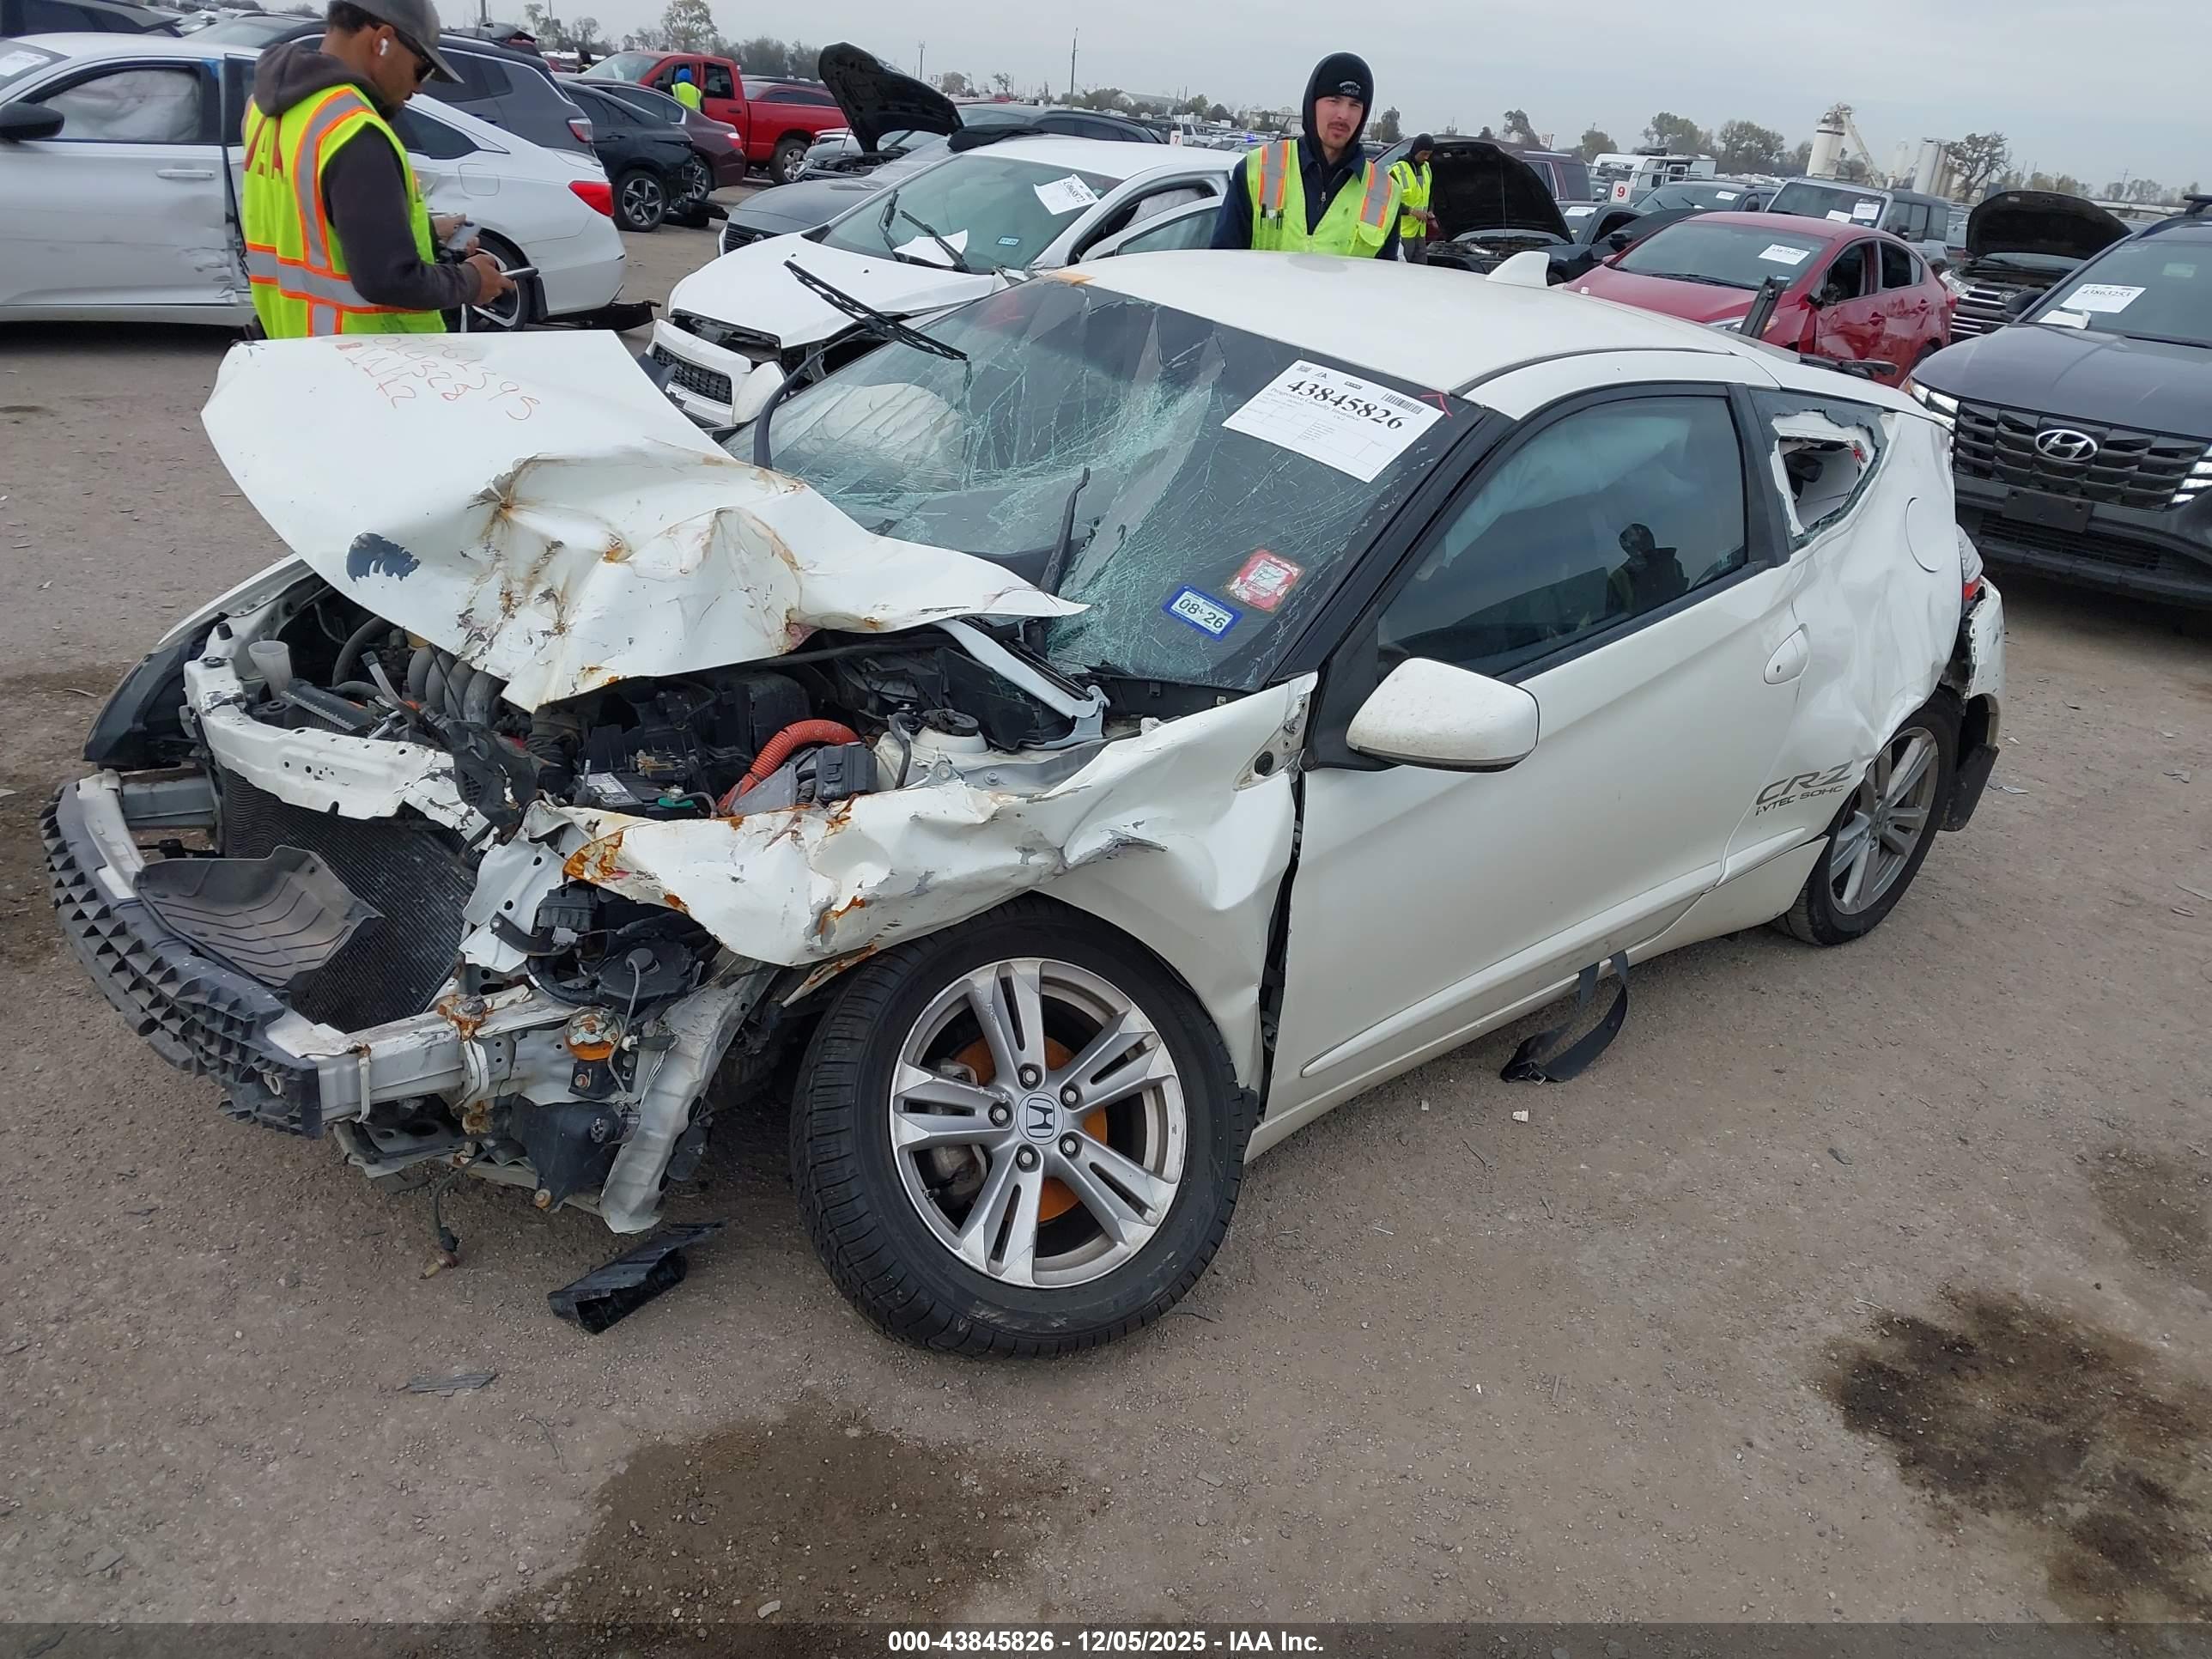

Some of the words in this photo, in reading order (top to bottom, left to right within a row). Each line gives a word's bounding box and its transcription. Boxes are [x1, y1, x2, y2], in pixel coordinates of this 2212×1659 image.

[1616, 185, 1626, 198] 9
[1286, 380, 1410, 430] 43845826
[1178, 599, 1200, 615] 08
[1203, 611, 1226, 629] 26
[1755, 759, 1854, 805] CR-Z
[1799, 785, 1844, 800] SOHC
